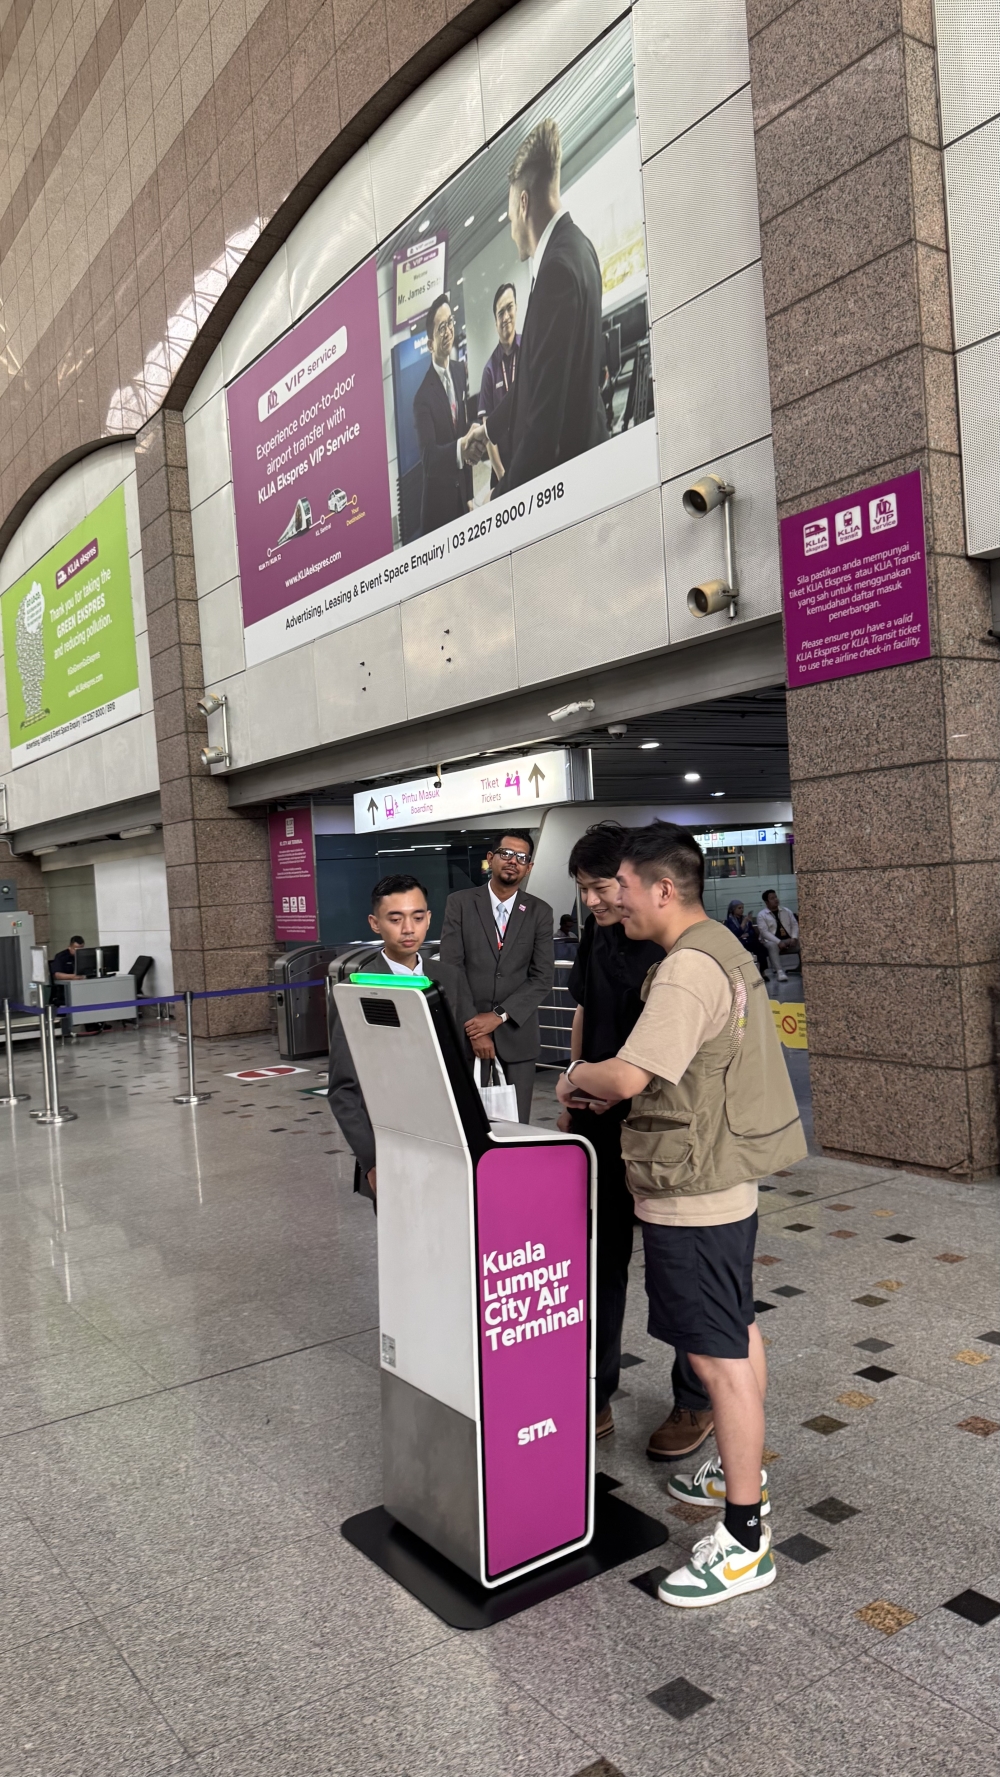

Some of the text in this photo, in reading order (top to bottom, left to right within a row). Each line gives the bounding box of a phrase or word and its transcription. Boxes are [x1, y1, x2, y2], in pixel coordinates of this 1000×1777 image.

[412, 256, 424, 267] VIP
[398, 294, 406, 304] Mr.
[407, 284, 426, 301] James
[284, 344, 337, 392] VIP service
[256, 374, 356, 460] Experience door-to-door
[266, 406, 346, 476] airport transfer with
[258, 422, 360, 504] KLIA Ekspres VIP Service
[346, 512, 366, 526] Destination
[838, 524, 860, 538] KLIA
[840, 532, 859, 542] transit
[872, 519, 896, 532] service
[874, 514, 894, 524] VIP
[286, 605, 324, 630] Advertising,
[325, 590, 352, 612] Leasing
[354, 584, 359, 598] &
[360, 573, 382, 594] Event
[384, 562, 409, 583] Space
[410, 544, 444, 570] Enquiry
[452, 531, 466, 550] 03
[468, 517, 492, 542] 2267
[495, 502, 526, 528] 8000
[528, 494, 534, 514] /
[536, 482, 565, 508] 8918
[806, 536, 828, 548] KLIA
[806, 543, 828, 554] ekspres
[66, 546, 97, 576] KLIA ekspres
[284, 551, 342, 588] www.KLIAekspres.com
[788, 550, 921, 598] tiket KLIA Ekspres atau KLIA Transit
[796, 541, 910, 586] Sila pastikan anda mempunyai
[49, 602, 64, 622] Thank
[65, 596, 74, 615] you
[74, 588, 82, 605] for
[83, 576, 100, 598] taking
[100, 568, 112, 584] the
[798, 568, 912, 610] yang sah untuk menggunakan
[806, 580, 902, 616] kemudahan daftar masuk
[56, 592, 106, 638] GREEN EKSPRES
[828, 600, 882, 622] penerbangan.
[54, 614, 112, 660] and reducing pollution.
[796, 624, 922, 662] KLIA Ekspres or KLIA Transit ticket
[802, 638, 824, 650] Please
[824, 632, 850, 644] ensure
[850, 628, 865, 640] you
[866, 624, 886, 634] have
[894, 612, 914, 626] valid
[798, 636, 920, 672] to use the airline check-in facility.
[402, 788, 440, 804] Pintu Masuk
[480, 777, 500, 790] Tiket
[481, 792, 502, 804] Tickets
[410, 803, 434, 815] Boarding
[483, 1240, 546, 1276] Kuala
[484, 1259, 571, 1302] Lumpur
[484, 1281, 569, 1326] City Air
[486, 1300, 584, 1352] Terminal
[518, 1418, 558, 1446] SITA
